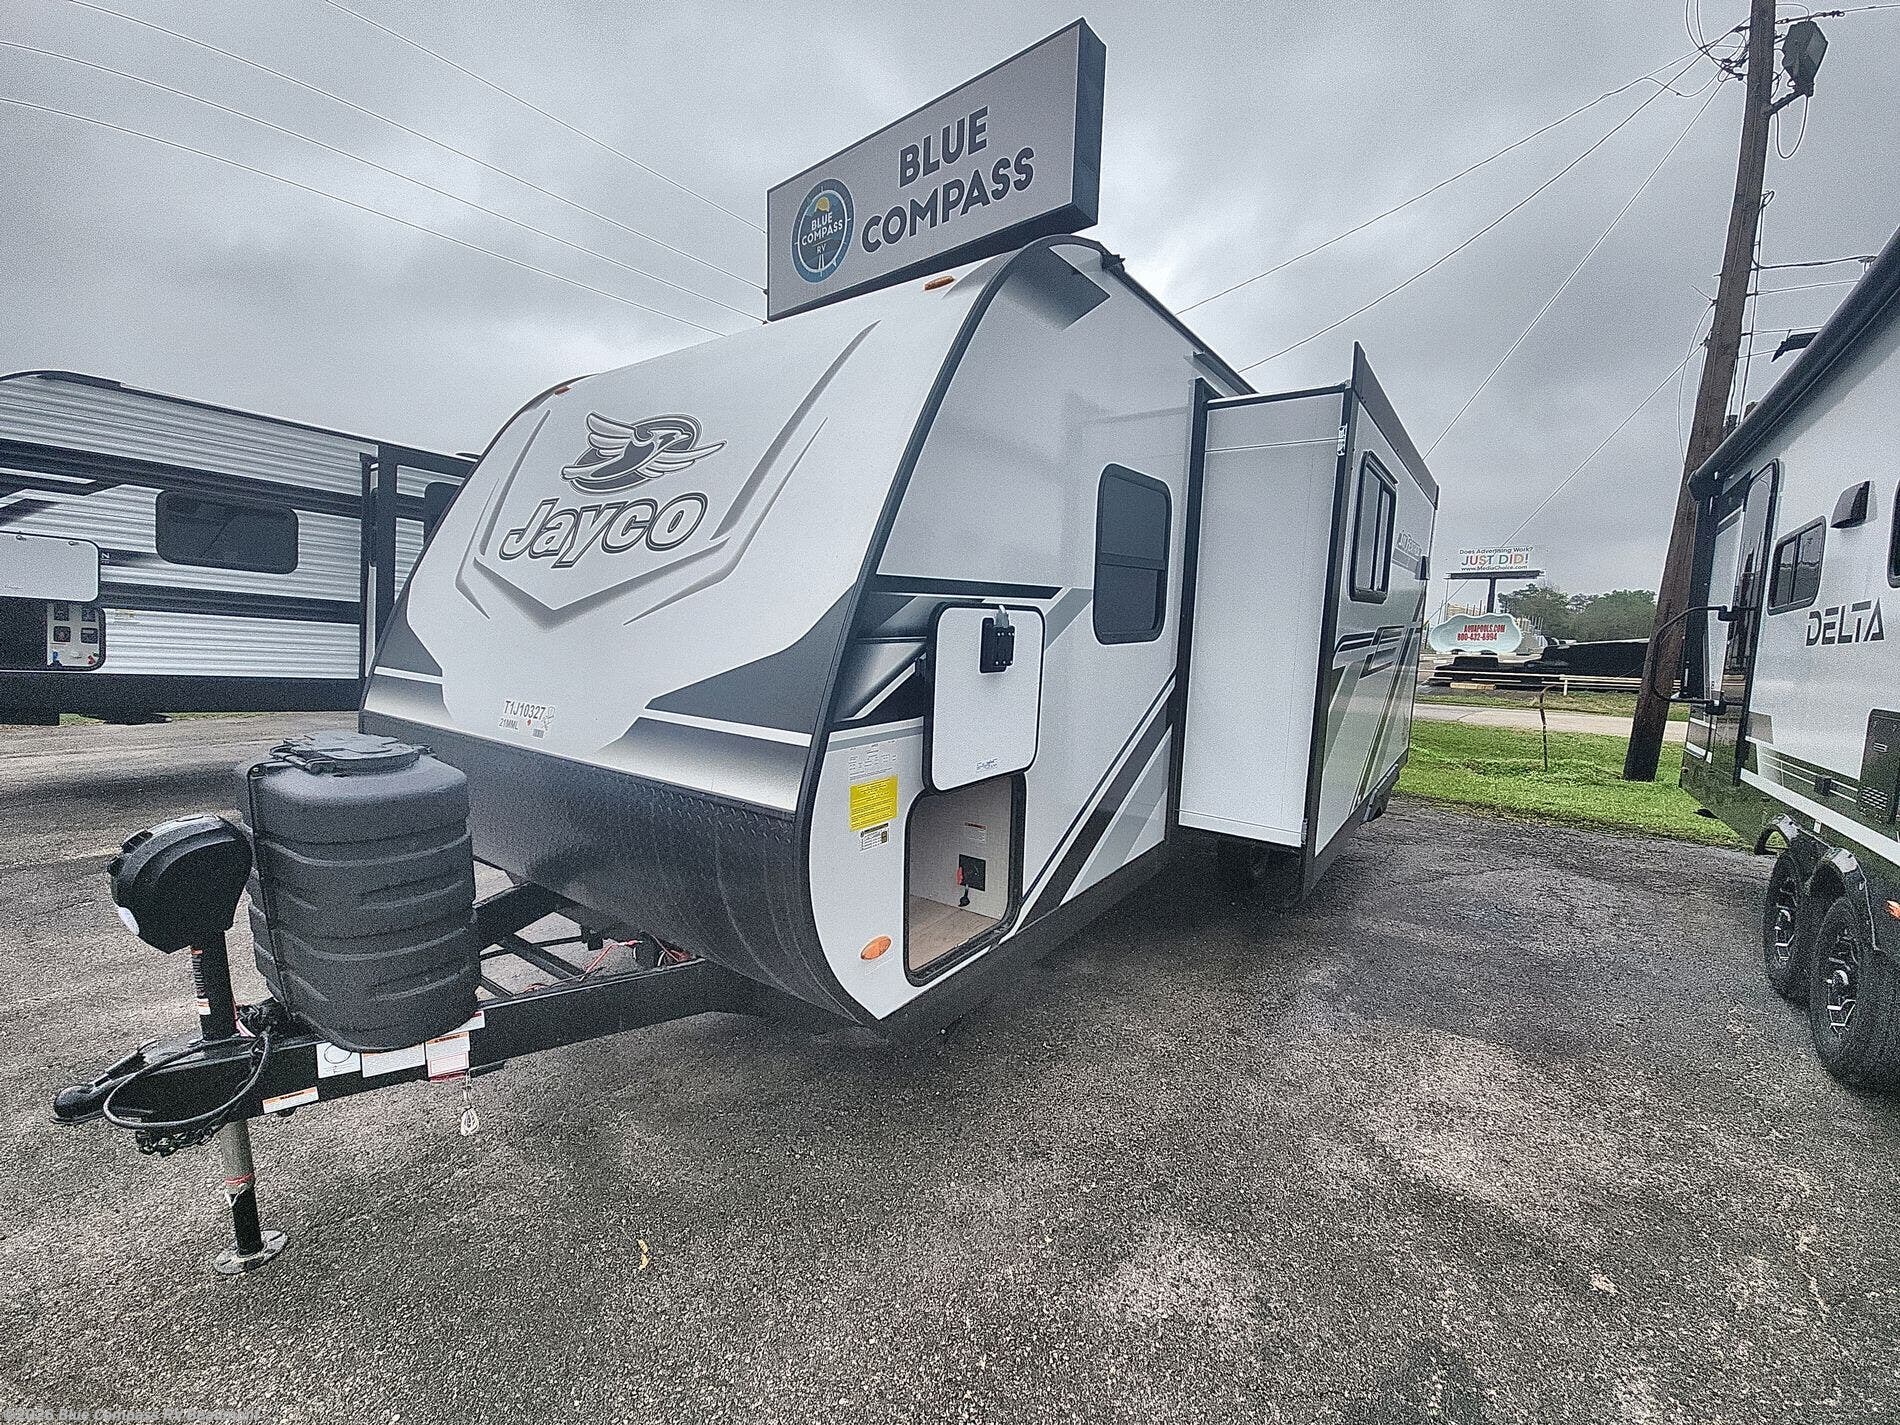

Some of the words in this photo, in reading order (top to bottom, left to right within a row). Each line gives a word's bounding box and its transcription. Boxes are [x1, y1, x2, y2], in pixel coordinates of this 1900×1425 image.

[899, 105, 989, 188] BLUE
[861, 147, 1035, 253] COMPASS
[801, 219, 843, 246] COMPASS
[811, 211, 833, 231] BLUE
[816, 243, 827, 254] RV
[499, 492, 708, 569] Jayco
[1461, 555, 1495, 566] JUST
[1498, 553, 1529, 565] DID!
[1805, 597, 1885, 647] DELTA
[503, 700, 546, 721] T1J10327
